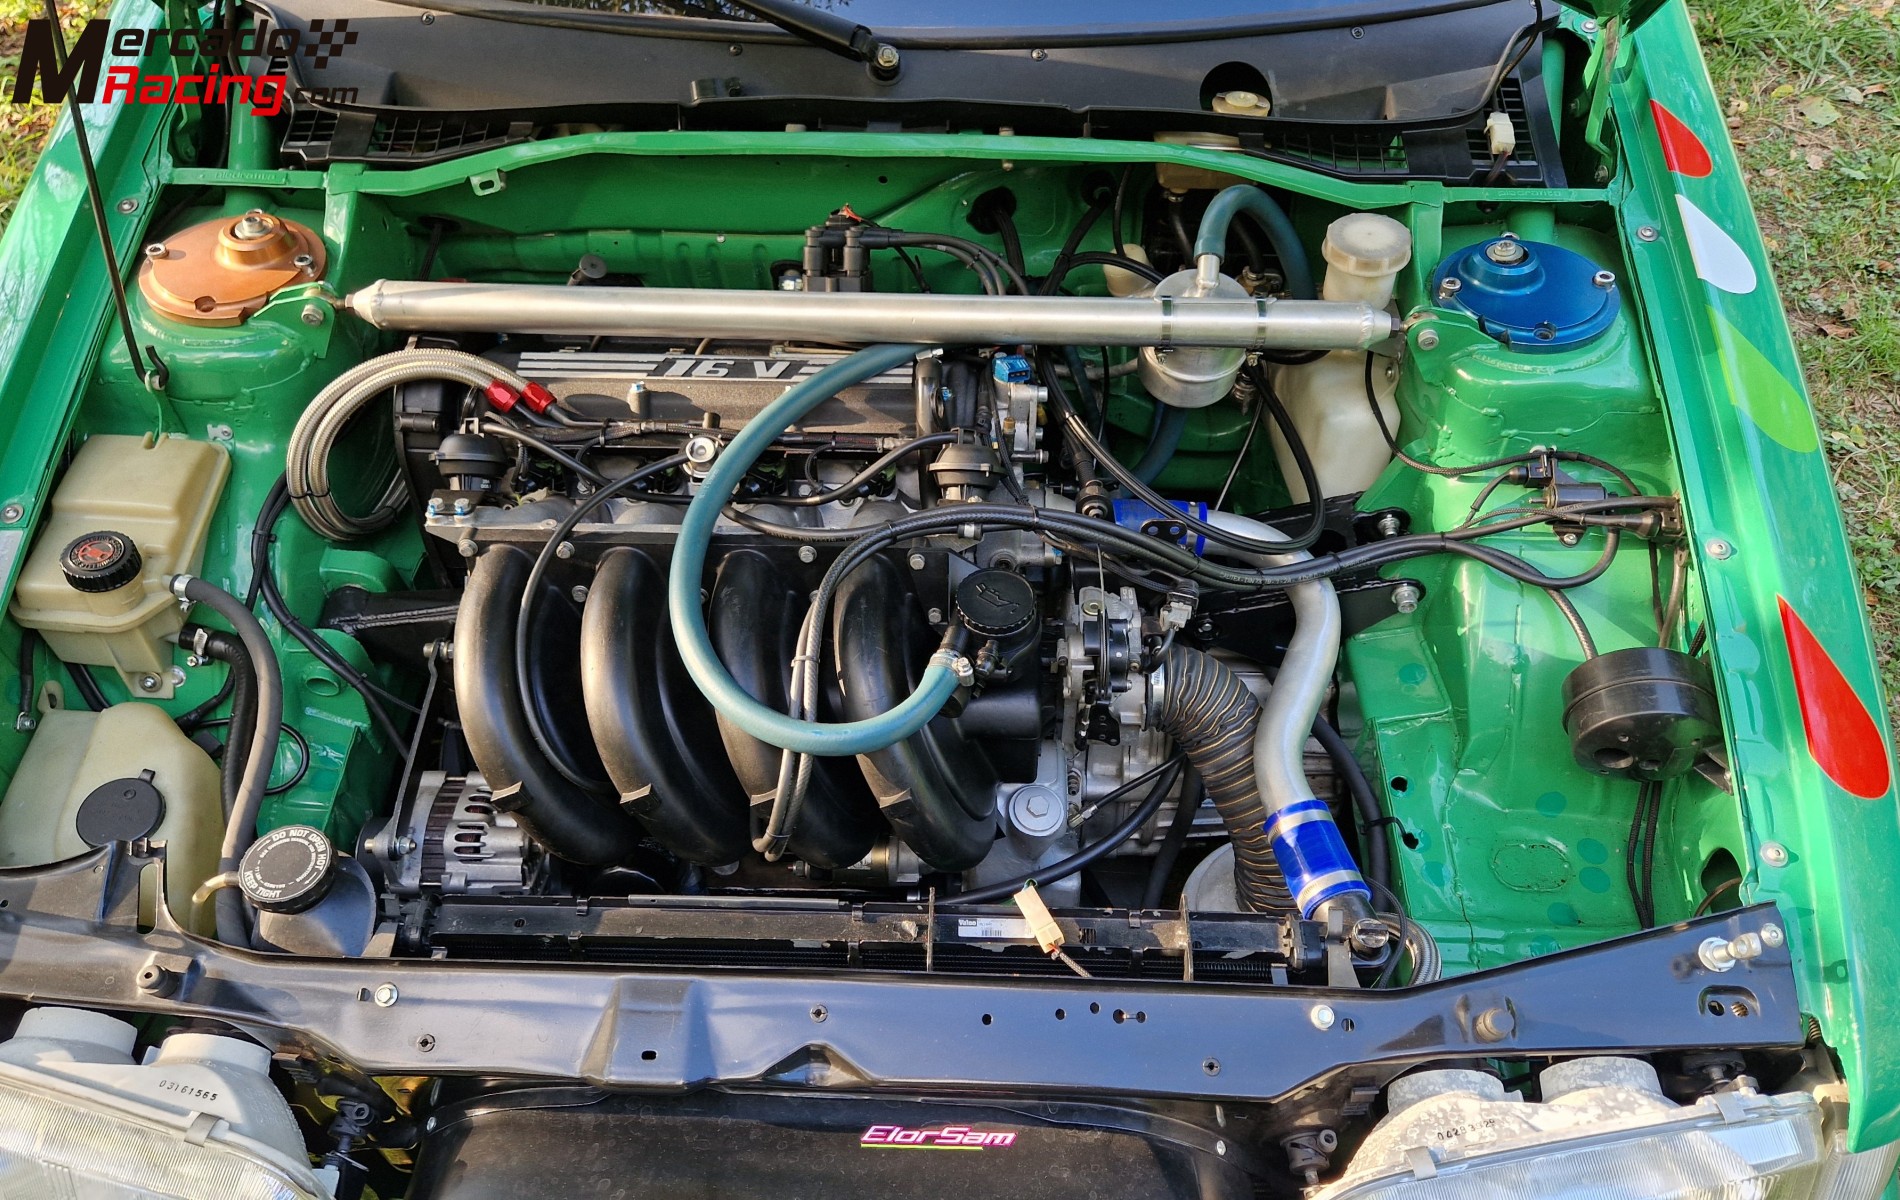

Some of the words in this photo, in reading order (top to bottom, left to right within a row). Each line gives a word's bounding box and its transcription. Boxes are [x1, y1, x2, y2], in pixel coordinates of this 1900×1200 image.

[663, 359, 735, 378] 16
[752, 360, 793, 378] V
[272, 831, 286, 842] DO
[289, 829, 310, 838] NOT
[308, 833, 327, 852] OPEN
[315, 853, 327, 870] HOT
[244, 870, 259, 889] KEEP
[256, 887, 282, 898] TIGHT
[159, 1080, 218, 1101] 03161565
[860, 1125, 1018, 1147] ElorSam
